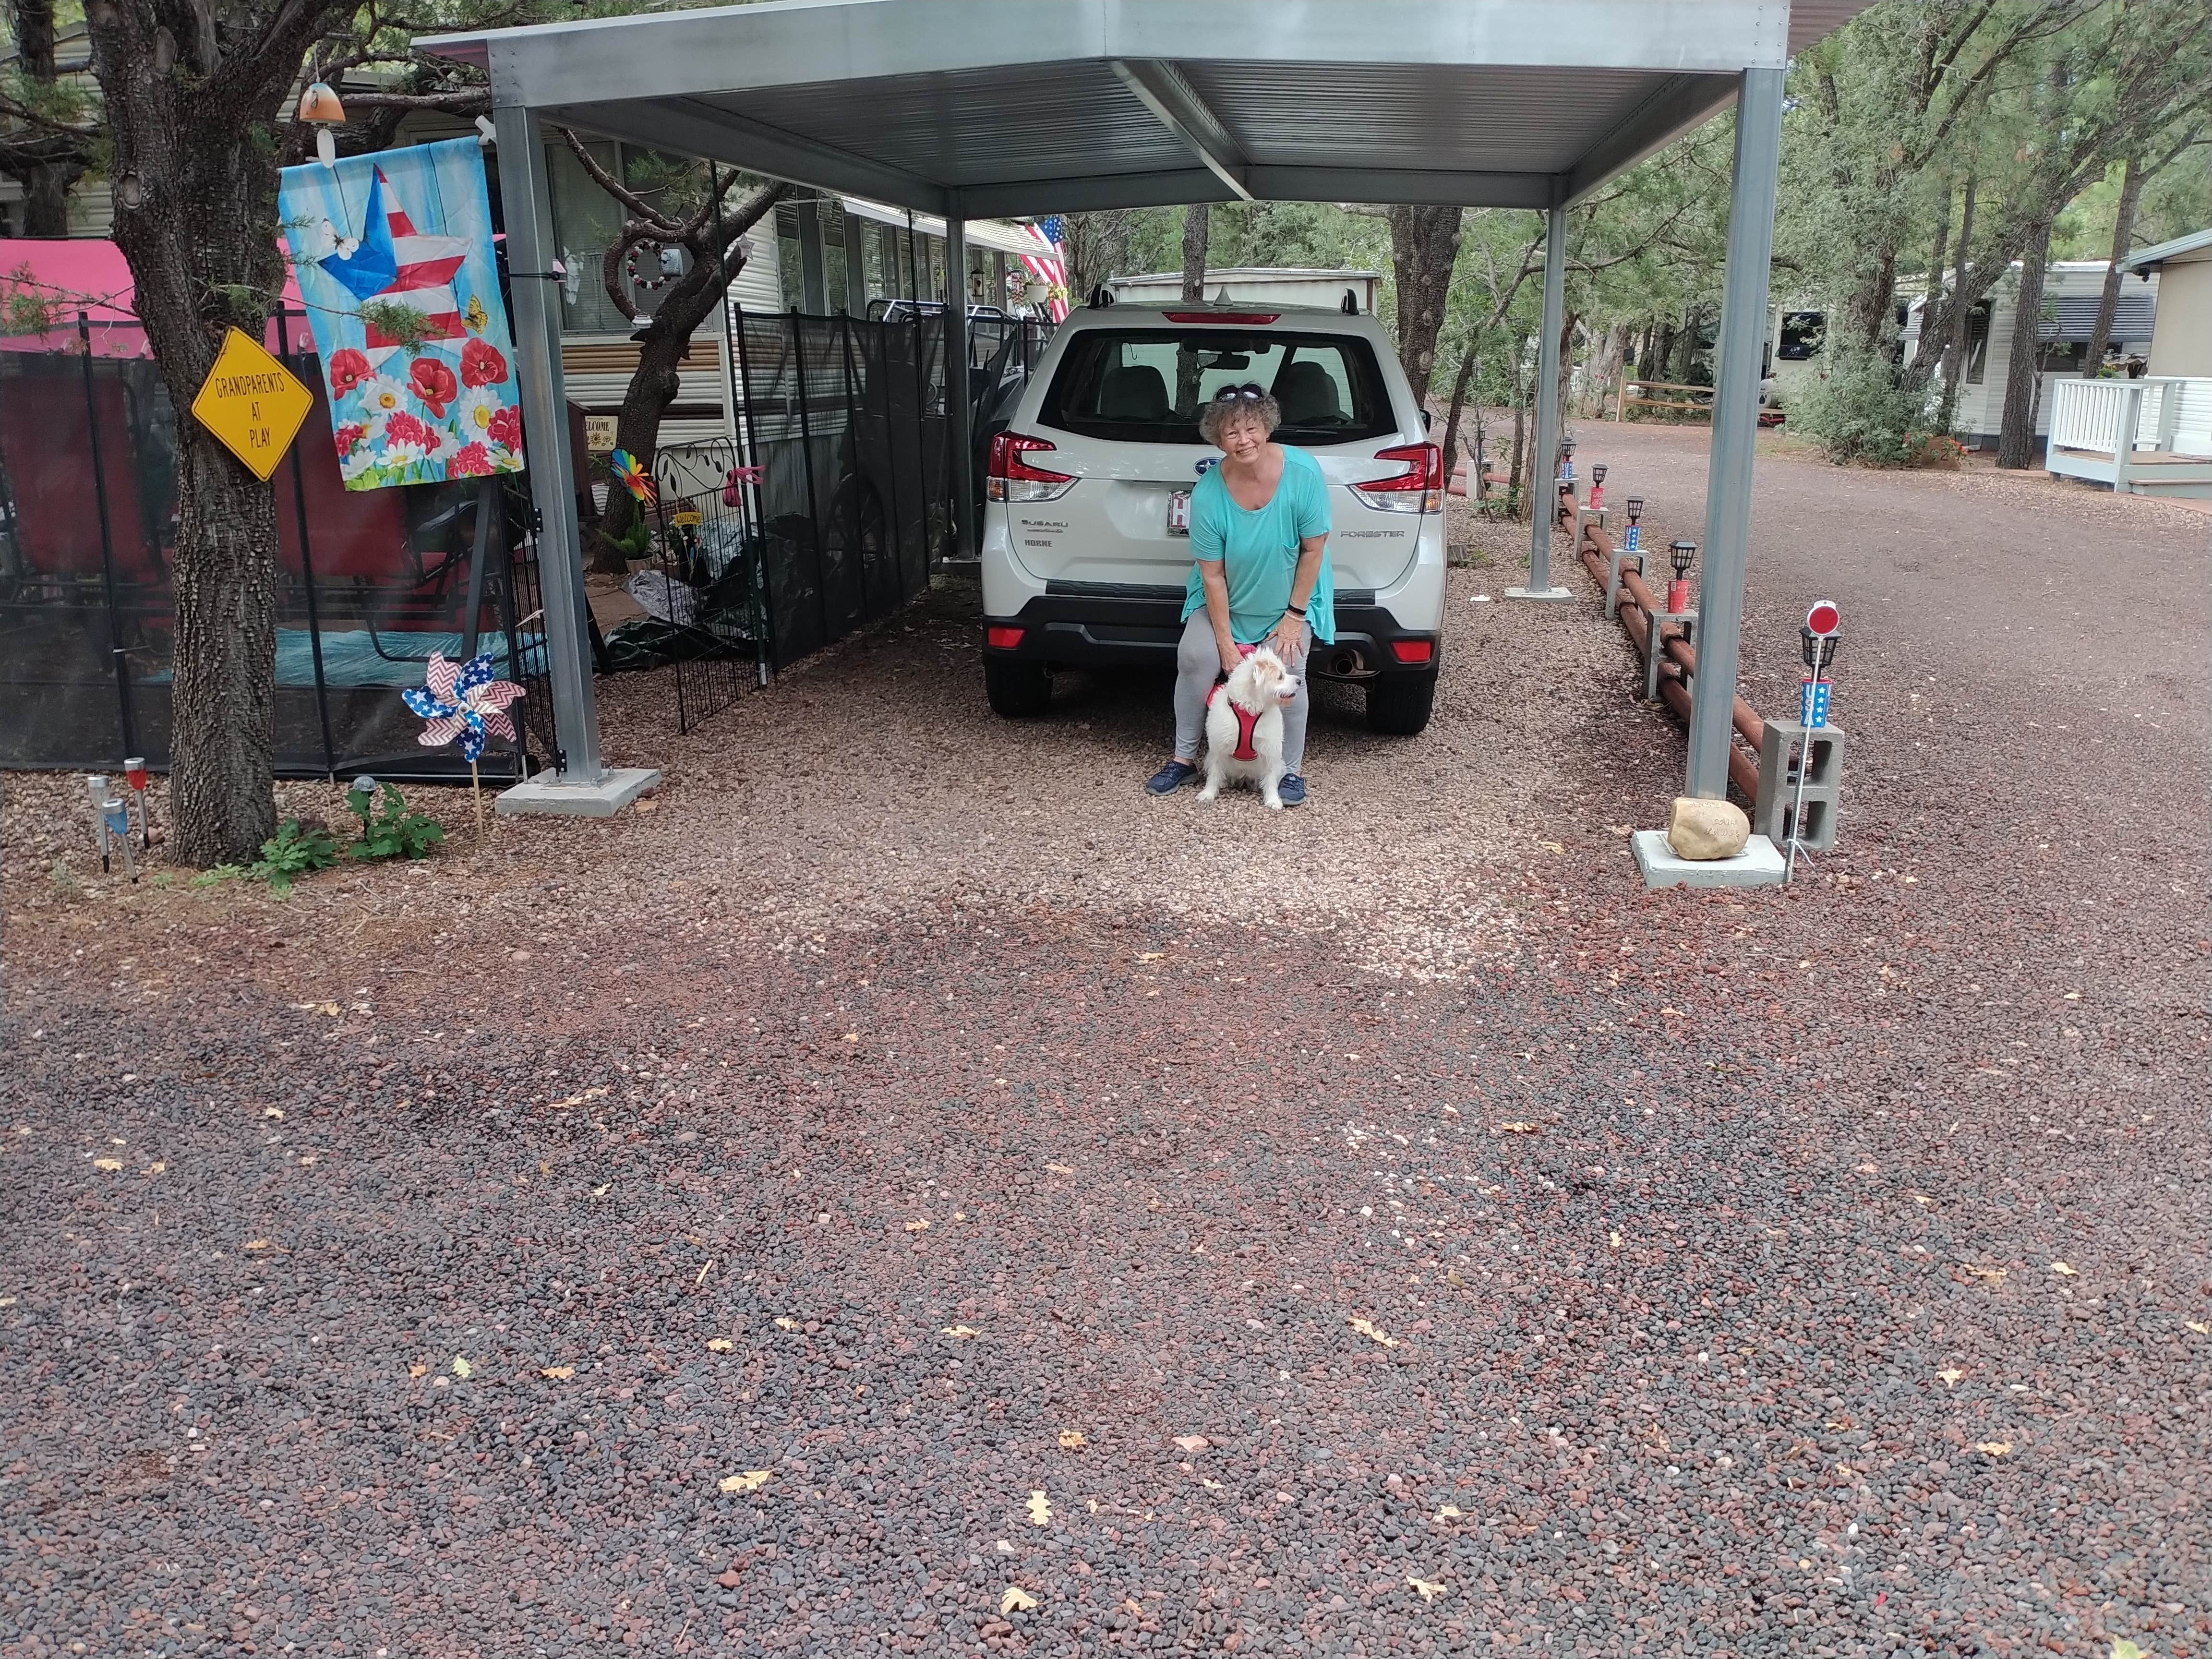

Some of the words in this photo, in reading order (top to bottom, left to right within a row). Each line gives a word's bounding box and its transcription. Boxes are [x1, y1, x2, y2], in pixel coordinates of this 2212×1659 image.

[216, 372, 285, 398] GRANDPARENTS
[251, 401, 261, 421] AT
[585, 421, 610, 431] ELCOME
[249, 427, 270, 448] PLAY
[1024, 539, 1053, 547] HORNE
